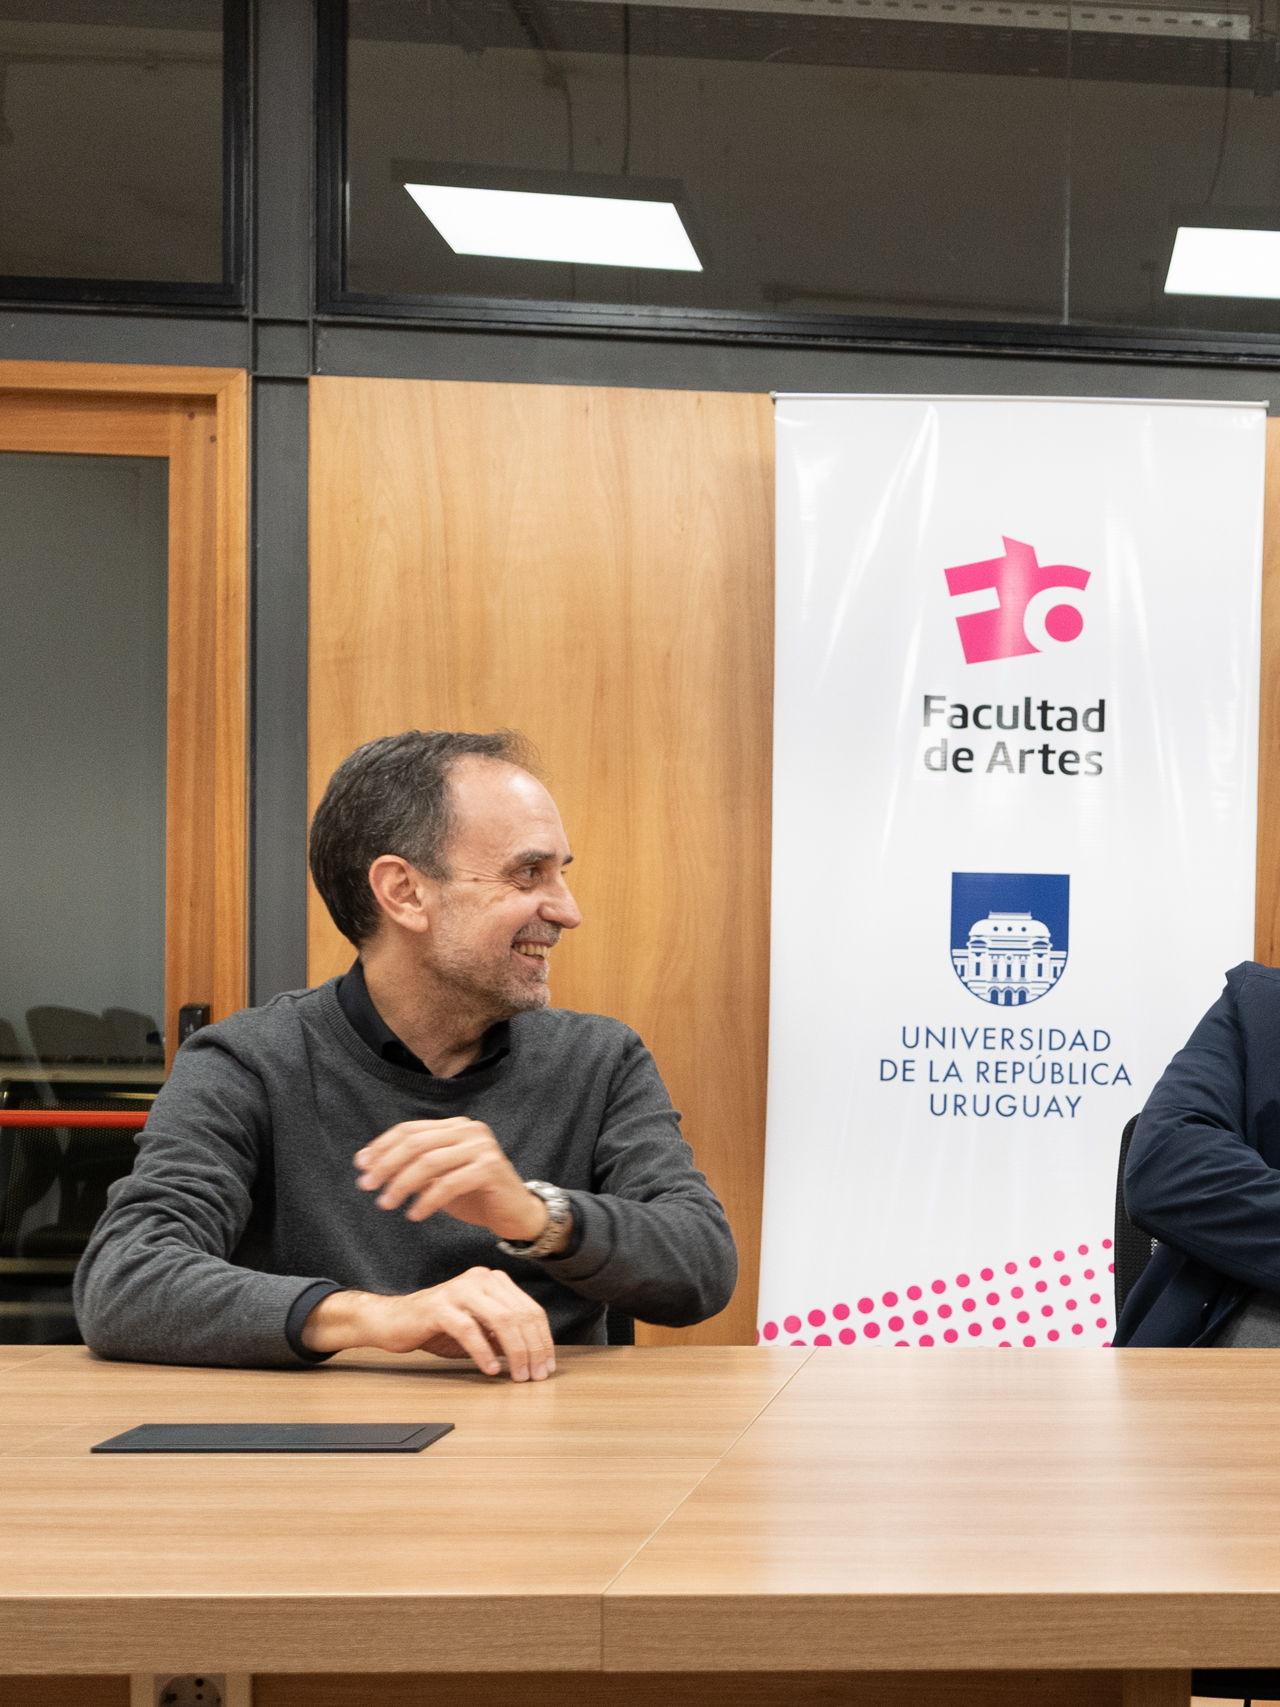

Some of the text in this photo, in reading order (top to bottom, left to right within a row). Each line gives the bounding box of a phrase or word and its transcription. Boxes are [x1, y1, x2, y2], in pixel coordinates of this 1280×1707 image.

[923, 694, 1106, 733] Facultad
[923, 738, 1104, 776] de Artes
[901, 1025, 1112, 1052] UNIVERSIDAD
[879, 1053, 1133, 1087] DE LA REPÚBLICA
[929, 1093, 1082, 1119] URUGUAY
